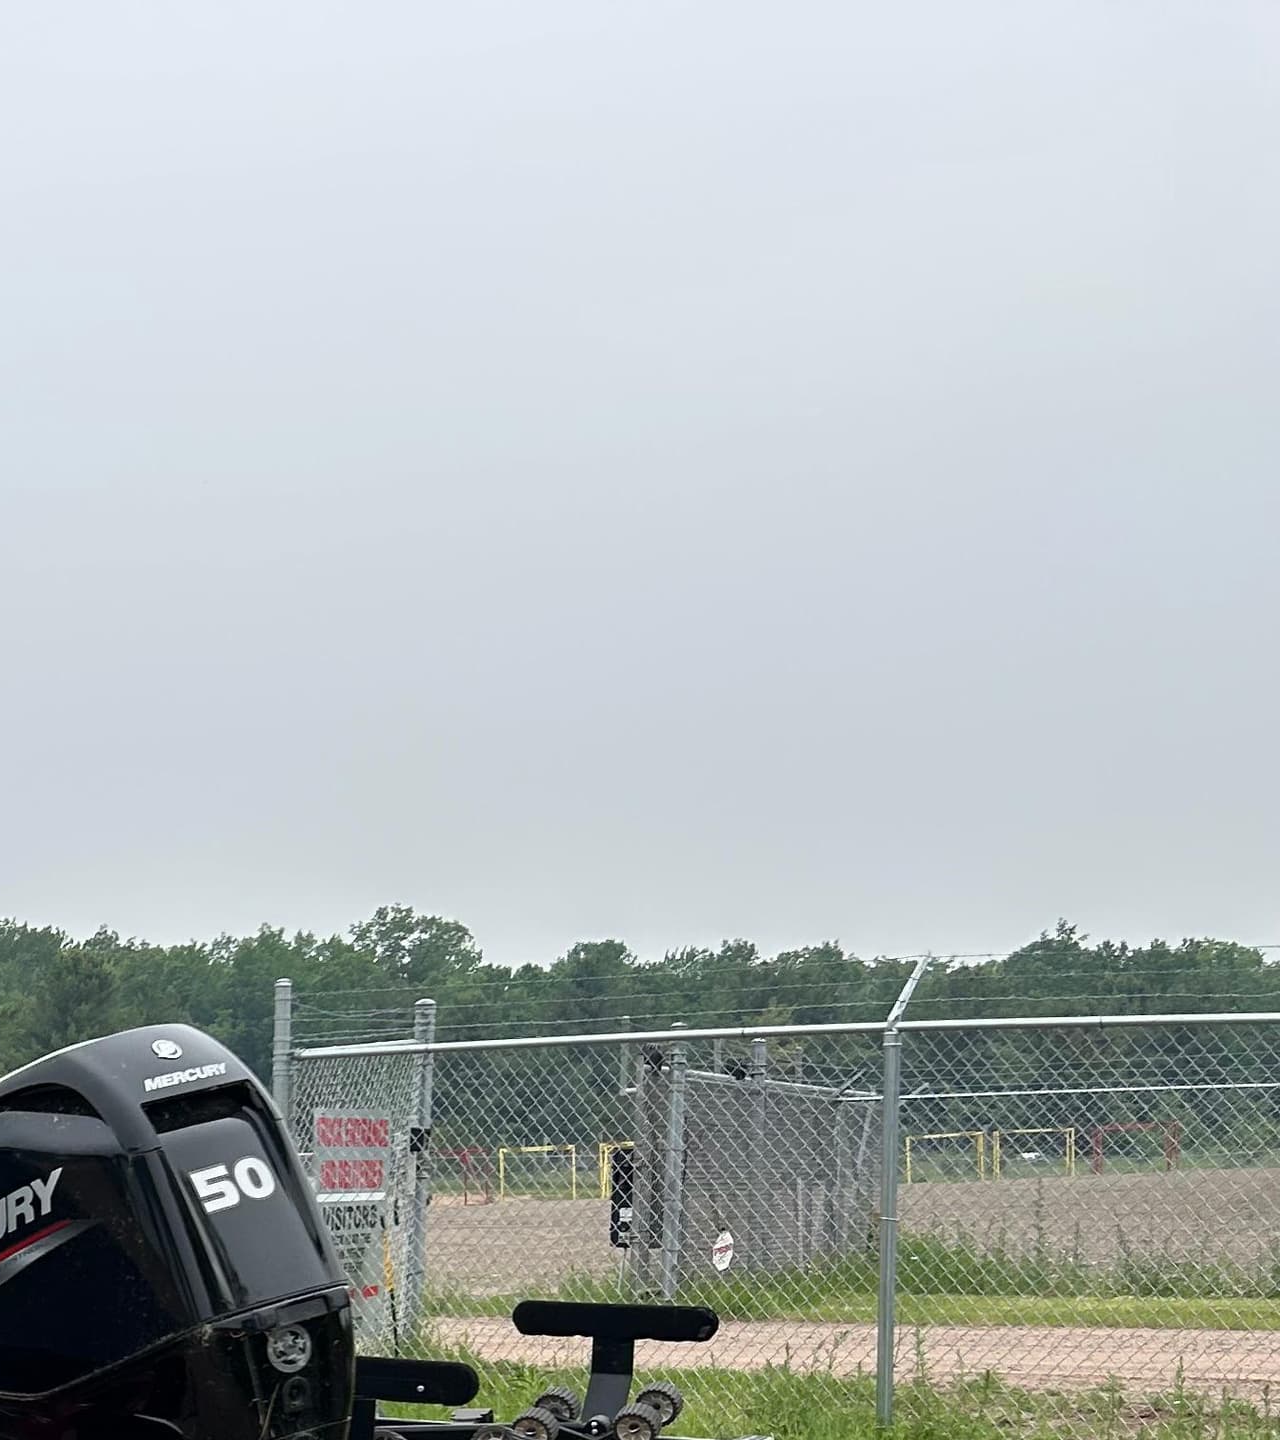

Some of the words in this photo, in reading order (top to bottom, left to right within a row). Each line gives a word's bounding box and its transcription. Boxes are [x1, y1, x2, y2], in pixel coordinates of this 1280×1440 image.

[143, 1062, 227, 1092] MERCURY
[190, 1156, 276, 1214] 50
[322, 1204, 377, 1230] VISITORS
